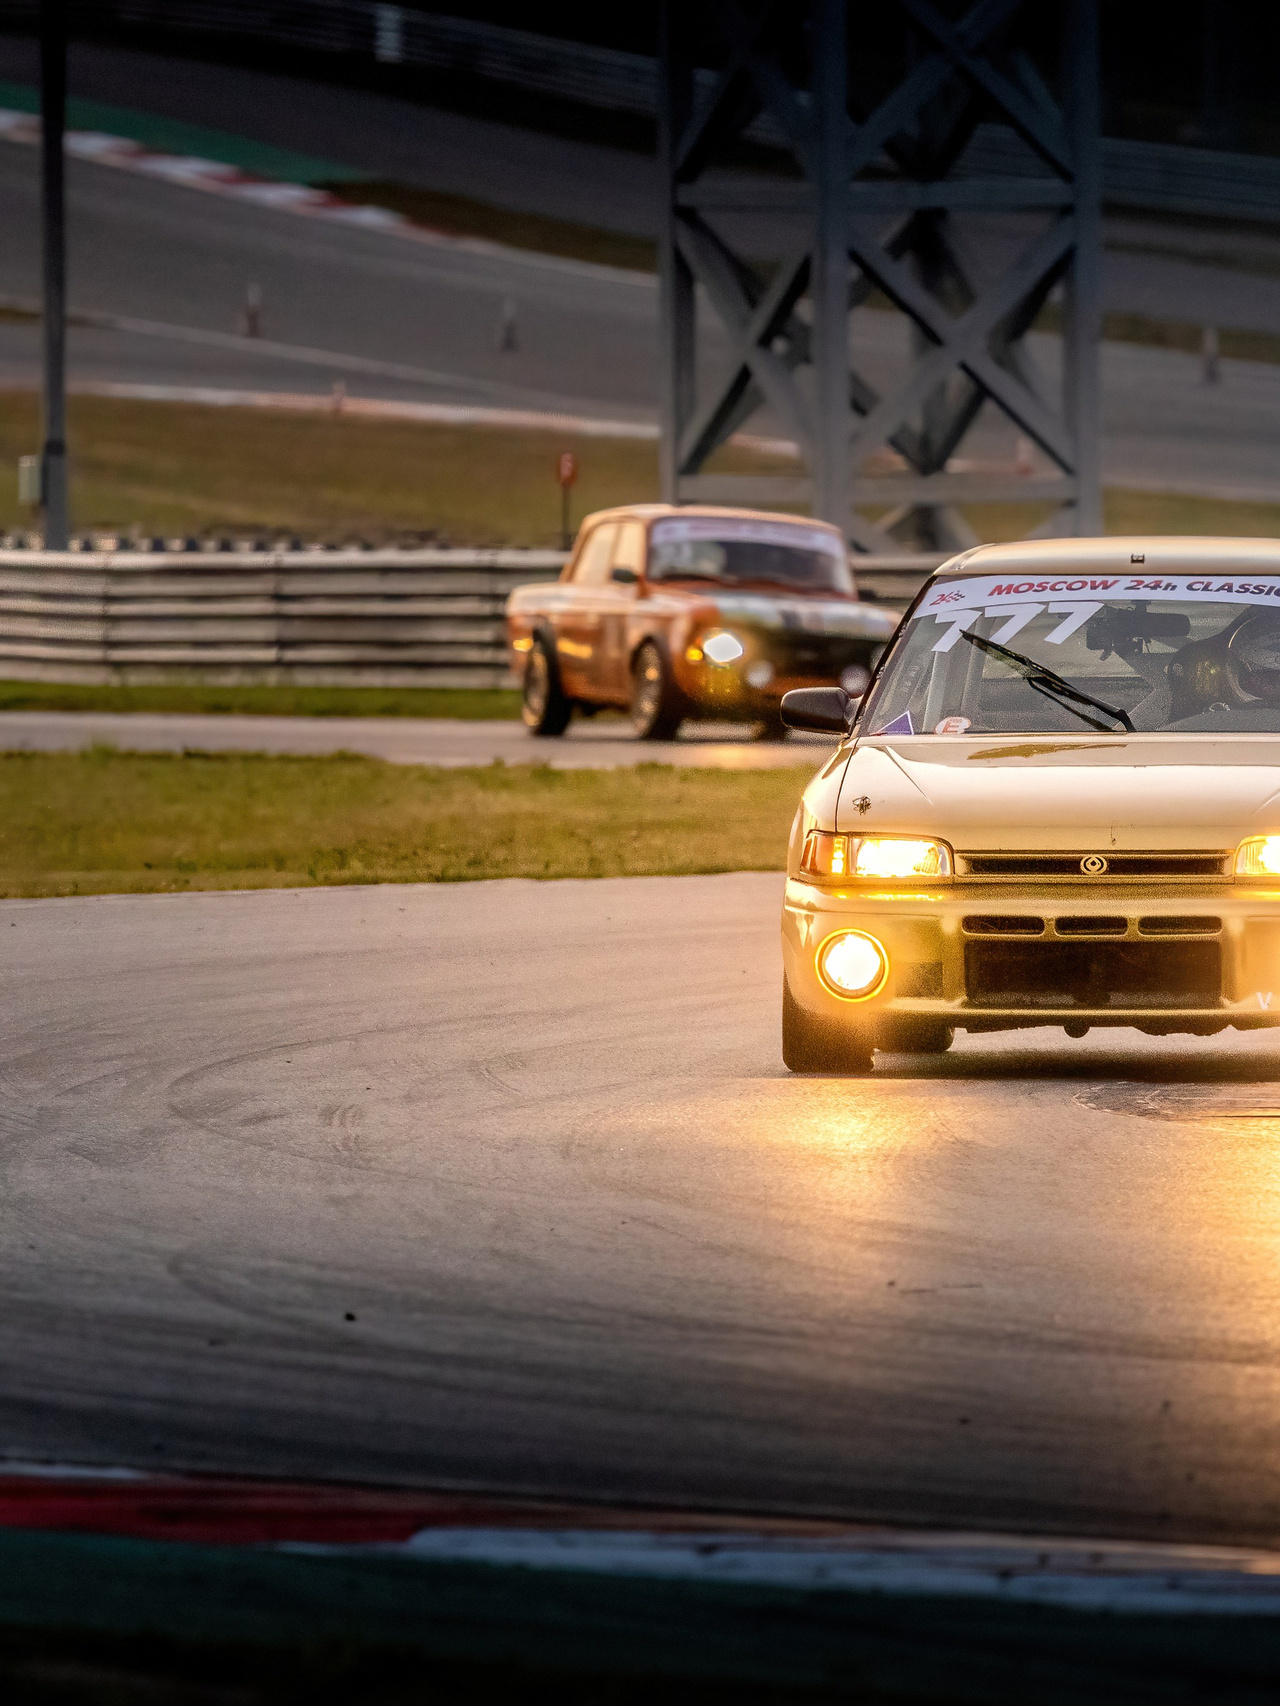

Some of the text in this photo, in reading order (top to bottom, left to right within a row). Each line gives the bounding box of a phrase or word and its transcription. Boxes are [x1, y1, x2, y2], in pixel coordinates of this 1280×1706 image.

[988, 580, 1120, 596] MOSCOW
[1124, 580, 1177, 591] 24h
[931, 601, 1104, 653] 777
